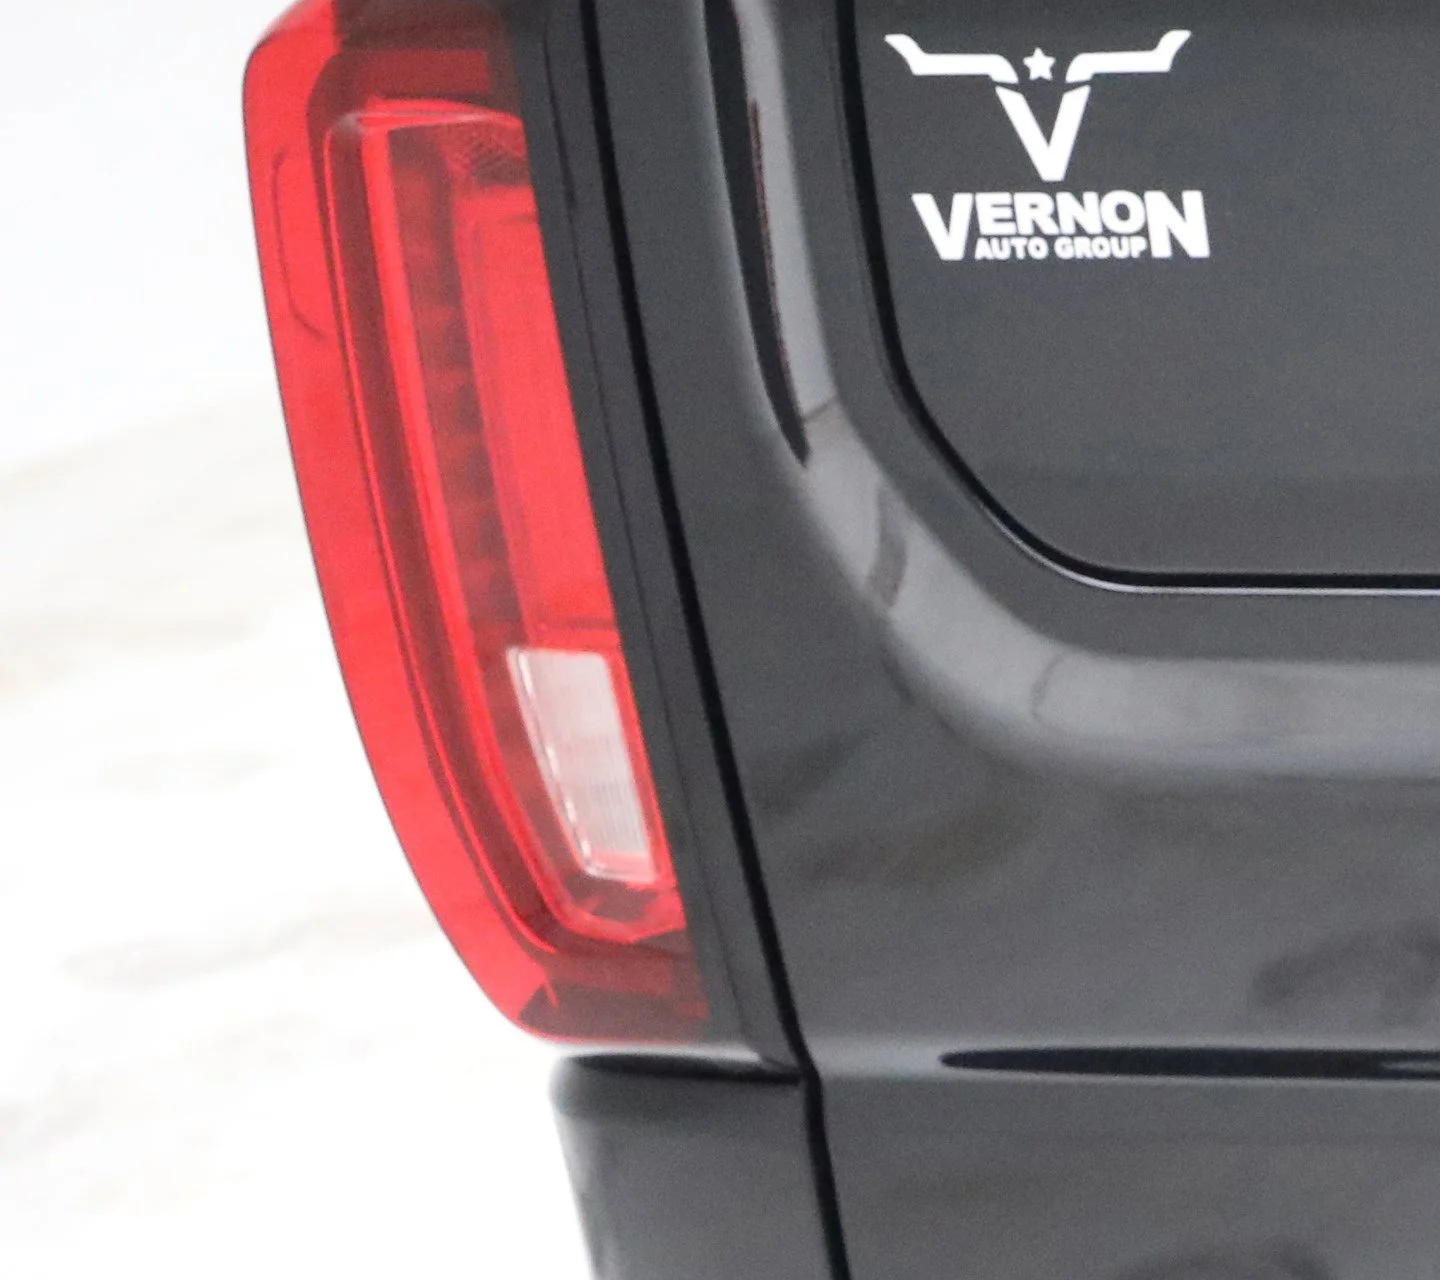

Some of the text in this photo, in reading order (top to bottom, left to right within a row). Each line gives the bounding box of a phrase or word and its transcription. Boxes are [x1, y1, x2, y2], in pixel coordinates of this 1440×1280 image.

[910, 189, 1211, 261] VERNON
[974, 235, 1148, 261] AUTO GROUP
